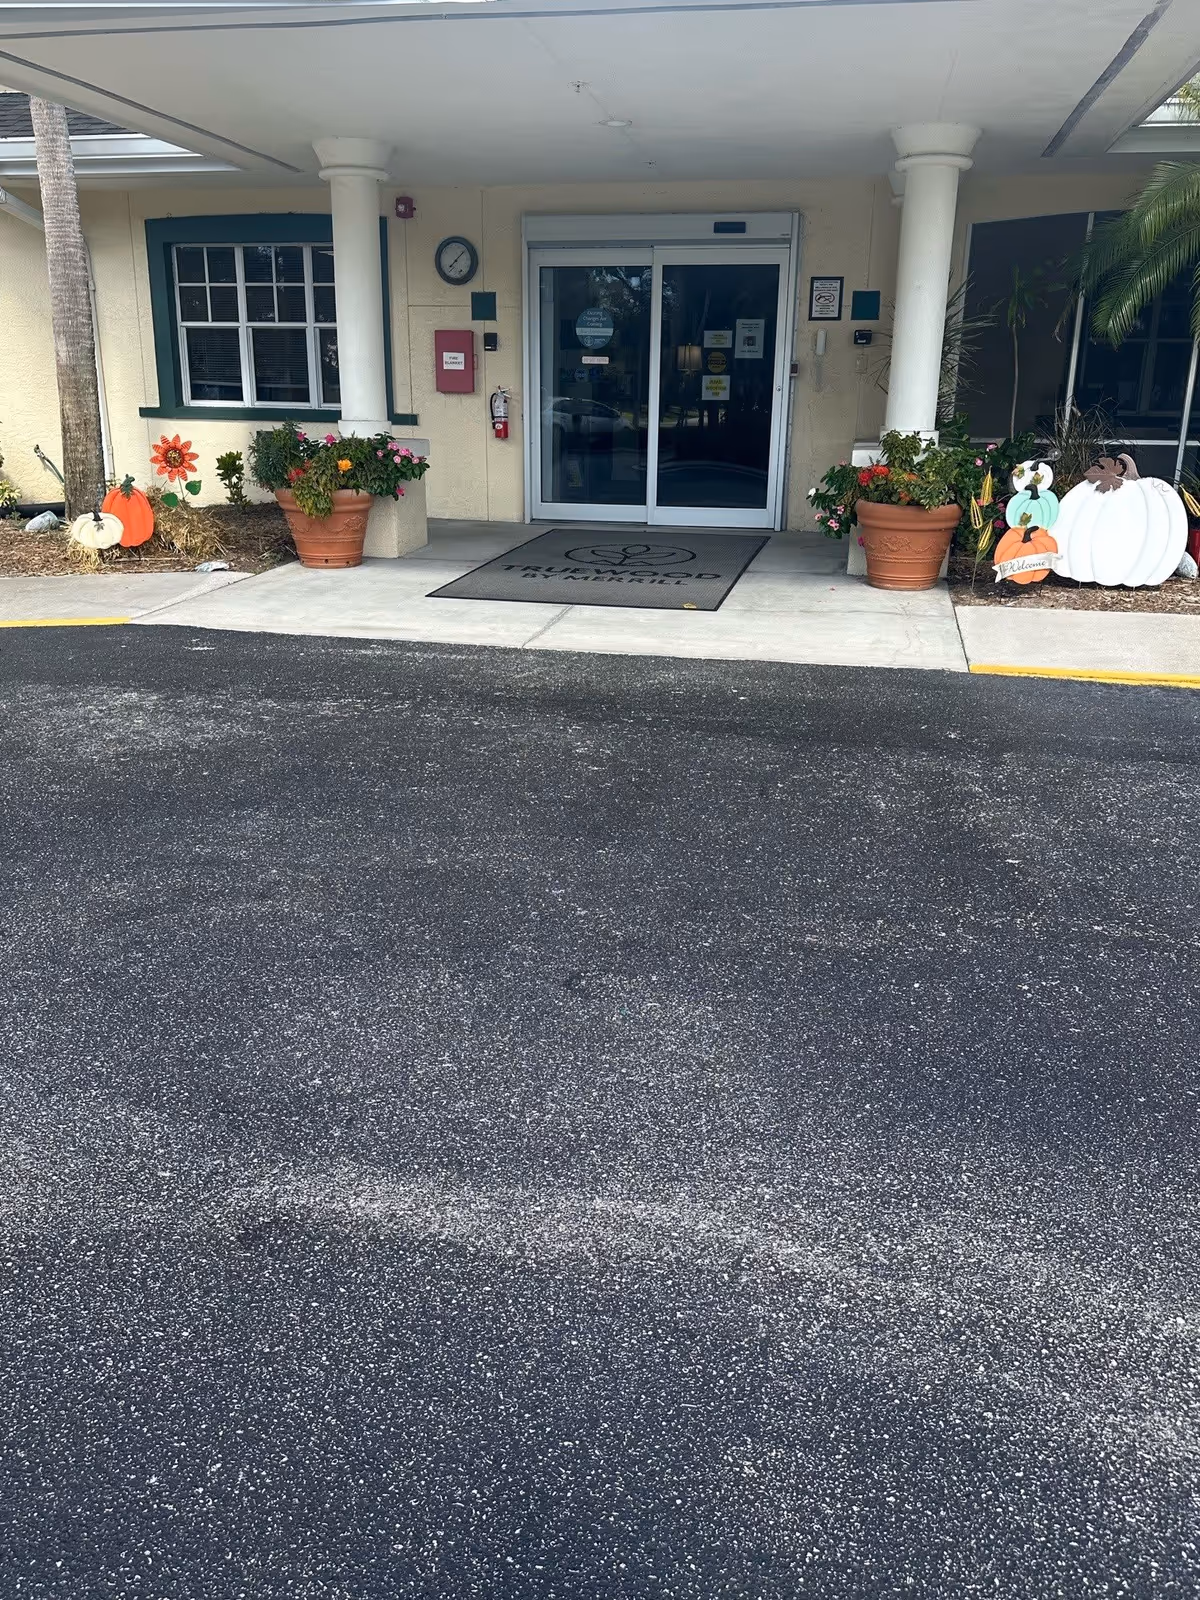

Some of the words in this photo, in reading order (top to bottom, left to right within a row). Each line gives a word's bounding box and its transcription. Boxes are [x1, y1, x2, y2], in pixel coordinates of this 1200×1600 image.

[501, 564, 721, 580] TRUEWOOD
[1008, 560, 1046, 572] Welcome
[563, 575, 689, 586] MERRILL
